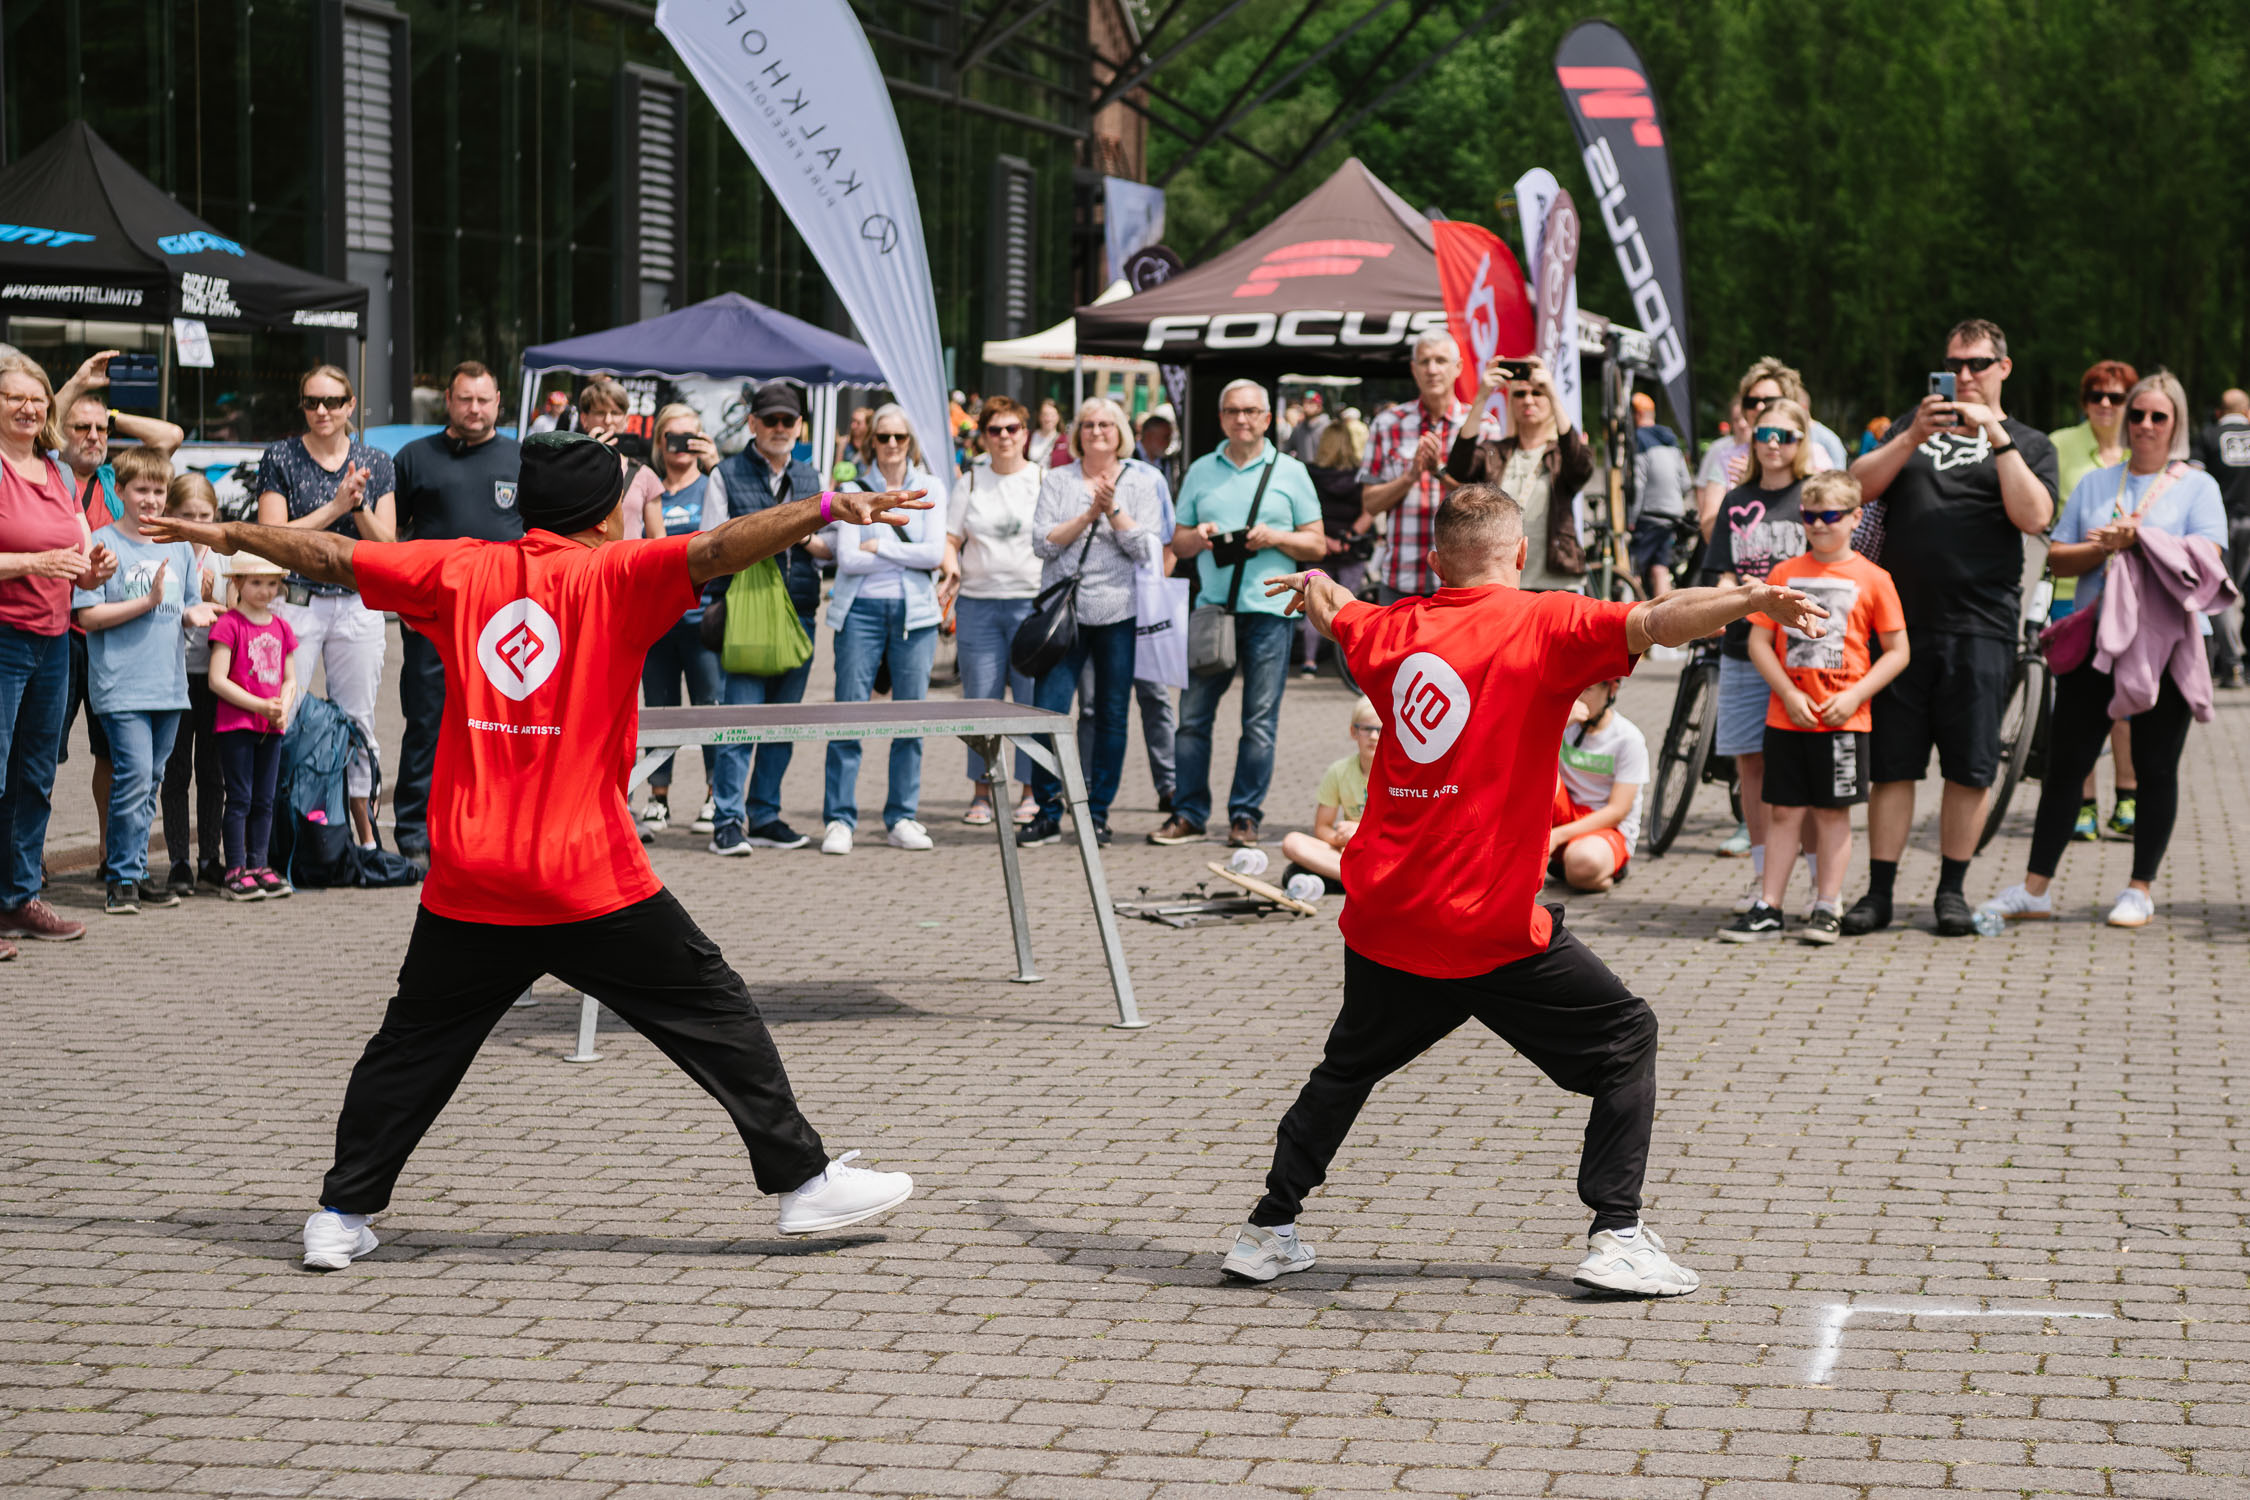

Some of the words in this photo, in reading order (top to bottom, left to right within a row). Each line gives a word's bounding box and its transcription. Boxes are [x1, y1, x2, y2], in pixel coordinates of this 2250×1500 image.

[182, 272, 207, 295] RIDE
[1, 284, 143, 306] #PUSHINGTHELIMITS
[521, 725, 561, 735] ARTISTS
